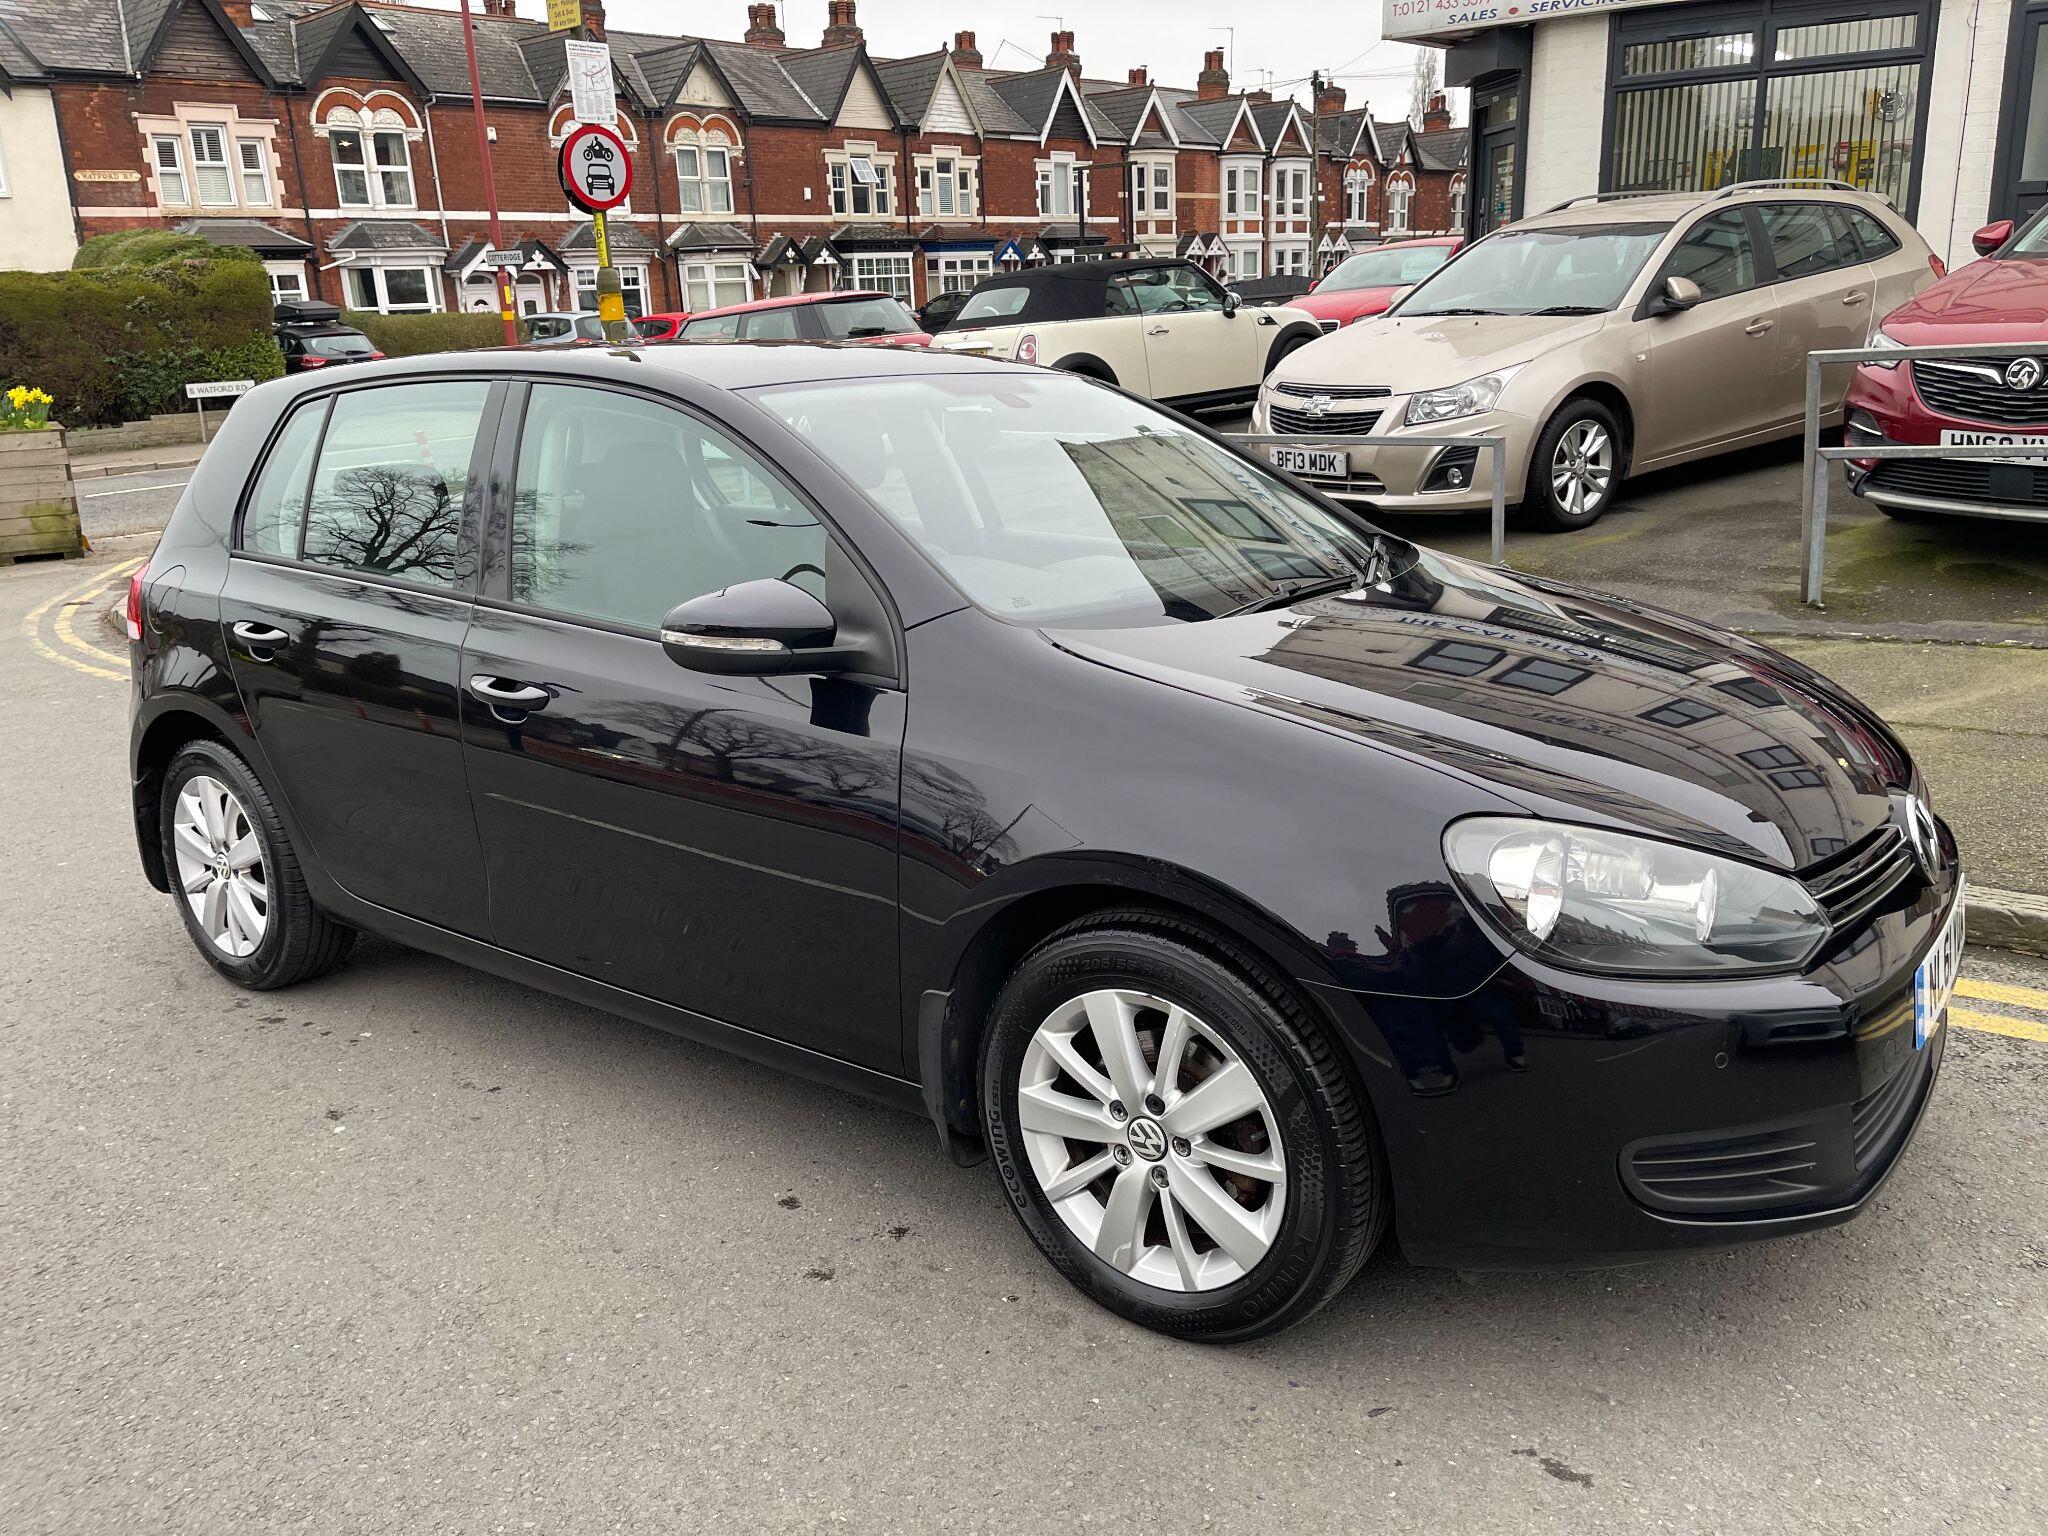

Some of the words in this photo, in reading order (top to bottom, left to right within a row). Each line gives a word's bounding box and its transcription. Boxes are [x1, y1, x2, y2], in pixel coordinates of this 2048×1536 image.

[1393, 0, 1430, 16] T:0121
[1436, 0, 1459, 10] 433
[1448, 9, 1498, 24] SALES
[1529, 0, 1626, 13] SERVIC
[597, 228, 603, 239] 6
[488, 253, 522, 262] COTTERIDGE
[197, 385, 234, 394] WATFORD
[1277, 450, 1305, 470] BF13
[1309, 453, 1337, 472] MDK
